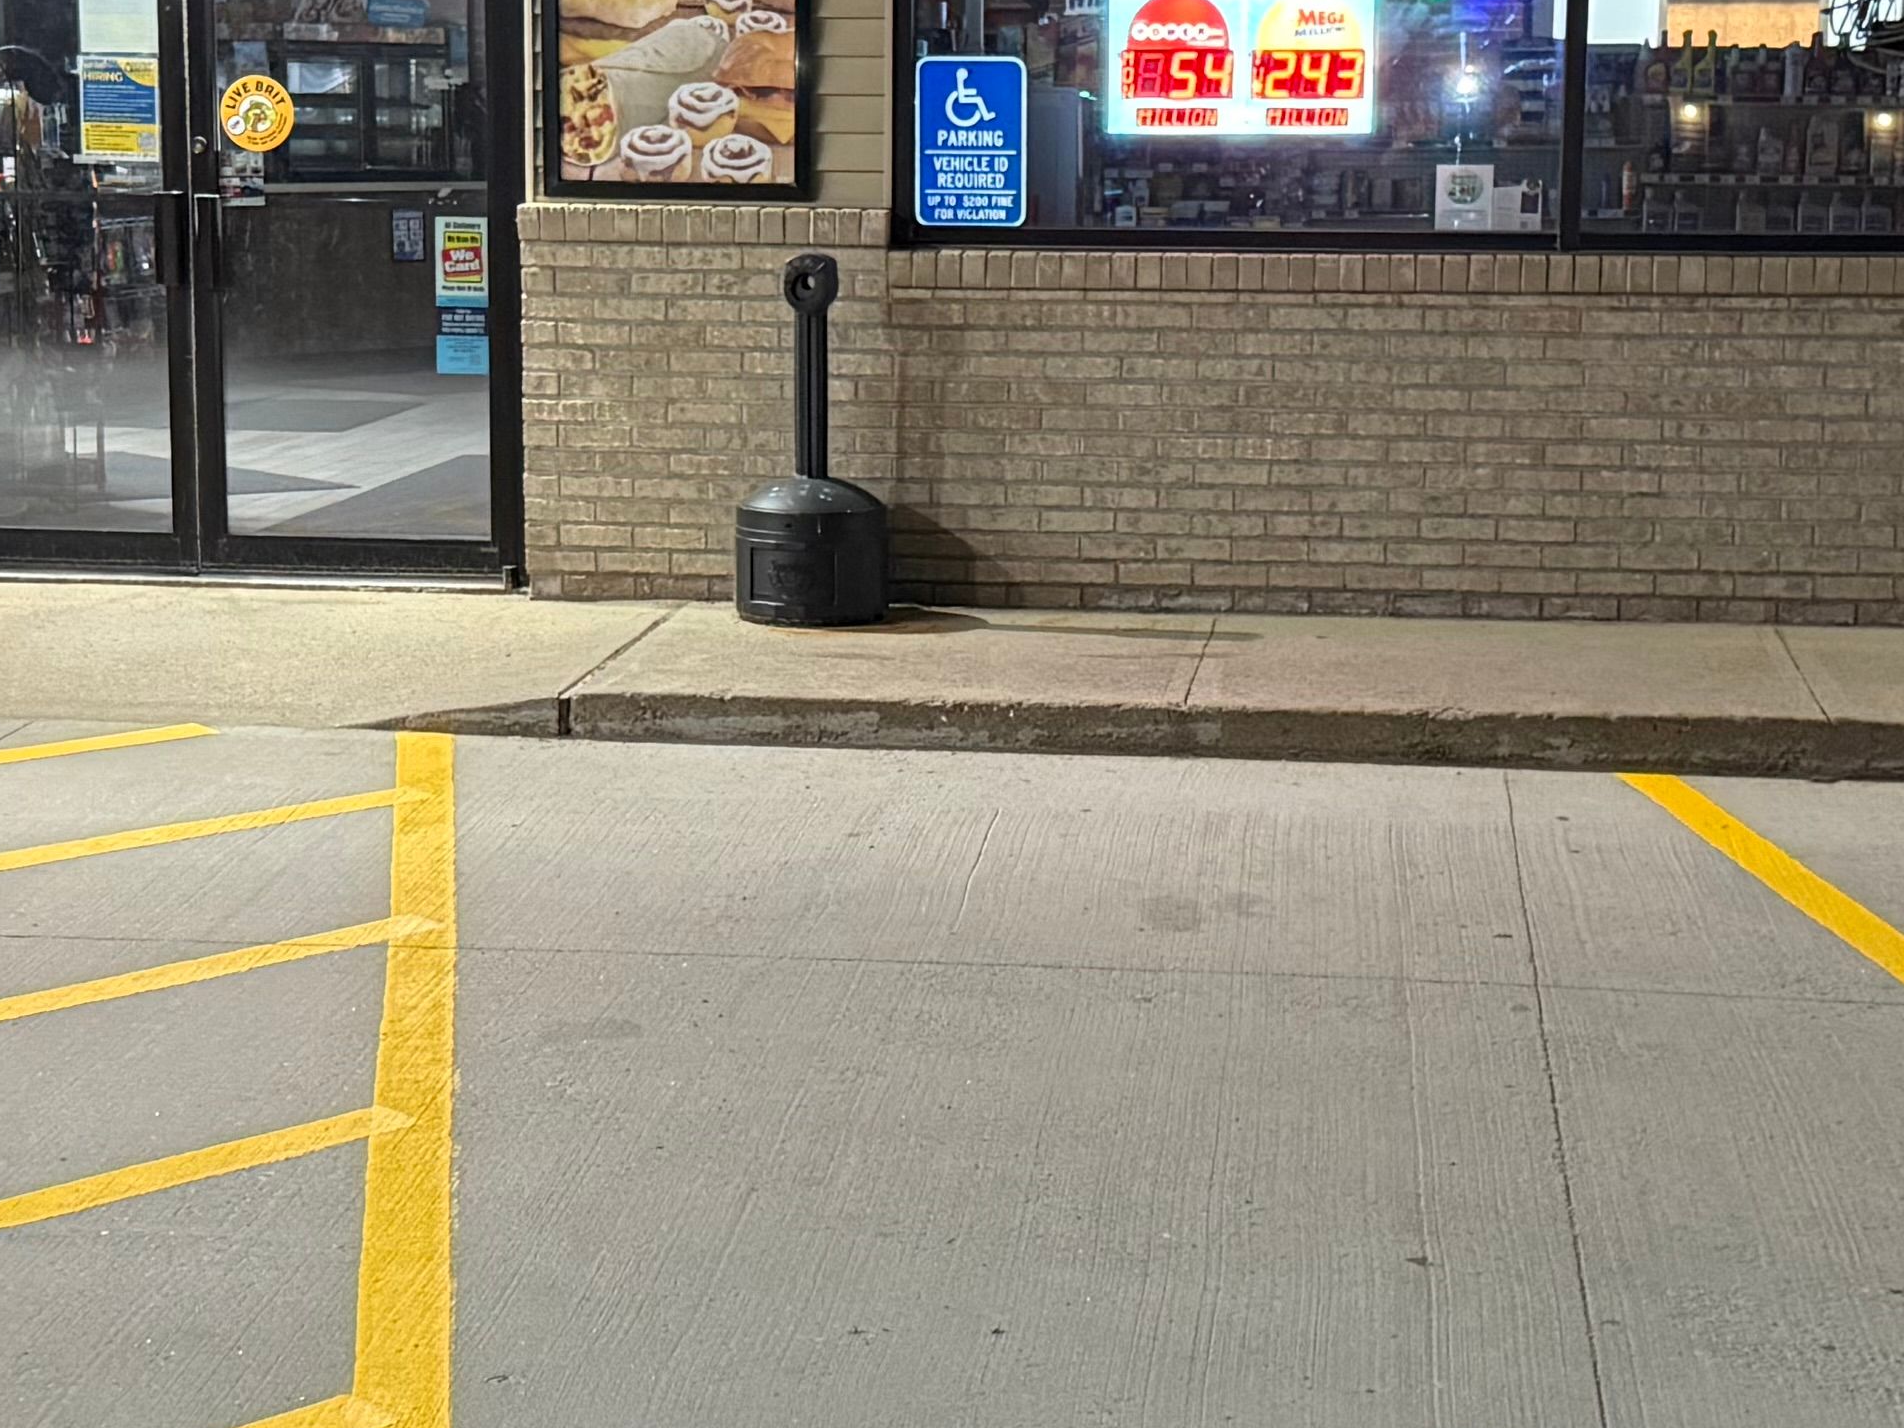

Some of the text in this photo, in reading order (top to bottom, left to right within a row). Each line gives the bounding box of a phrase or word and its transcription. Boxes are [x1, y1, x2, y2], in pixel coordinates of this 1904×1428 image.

[1264, 51, 1364, 99] 243
[225, 81, 251, 110] LIVE
[1138, 109, 1217, 125] MILLION
[1267, 109, 1348, 125] MILLION
[937, 129, 1004, 147] PARKING
[933, 156, 1008, 172] VEHICLE ID
[937, 172, 1005, 188] REQUIRED
[927, 196, 1014, 208] UP TO $200 FINE
[934, 208, 1006, 221] FOR VIOLATION
[449, 249, 475, 262] We
[445, 259, 481, 273] Card
